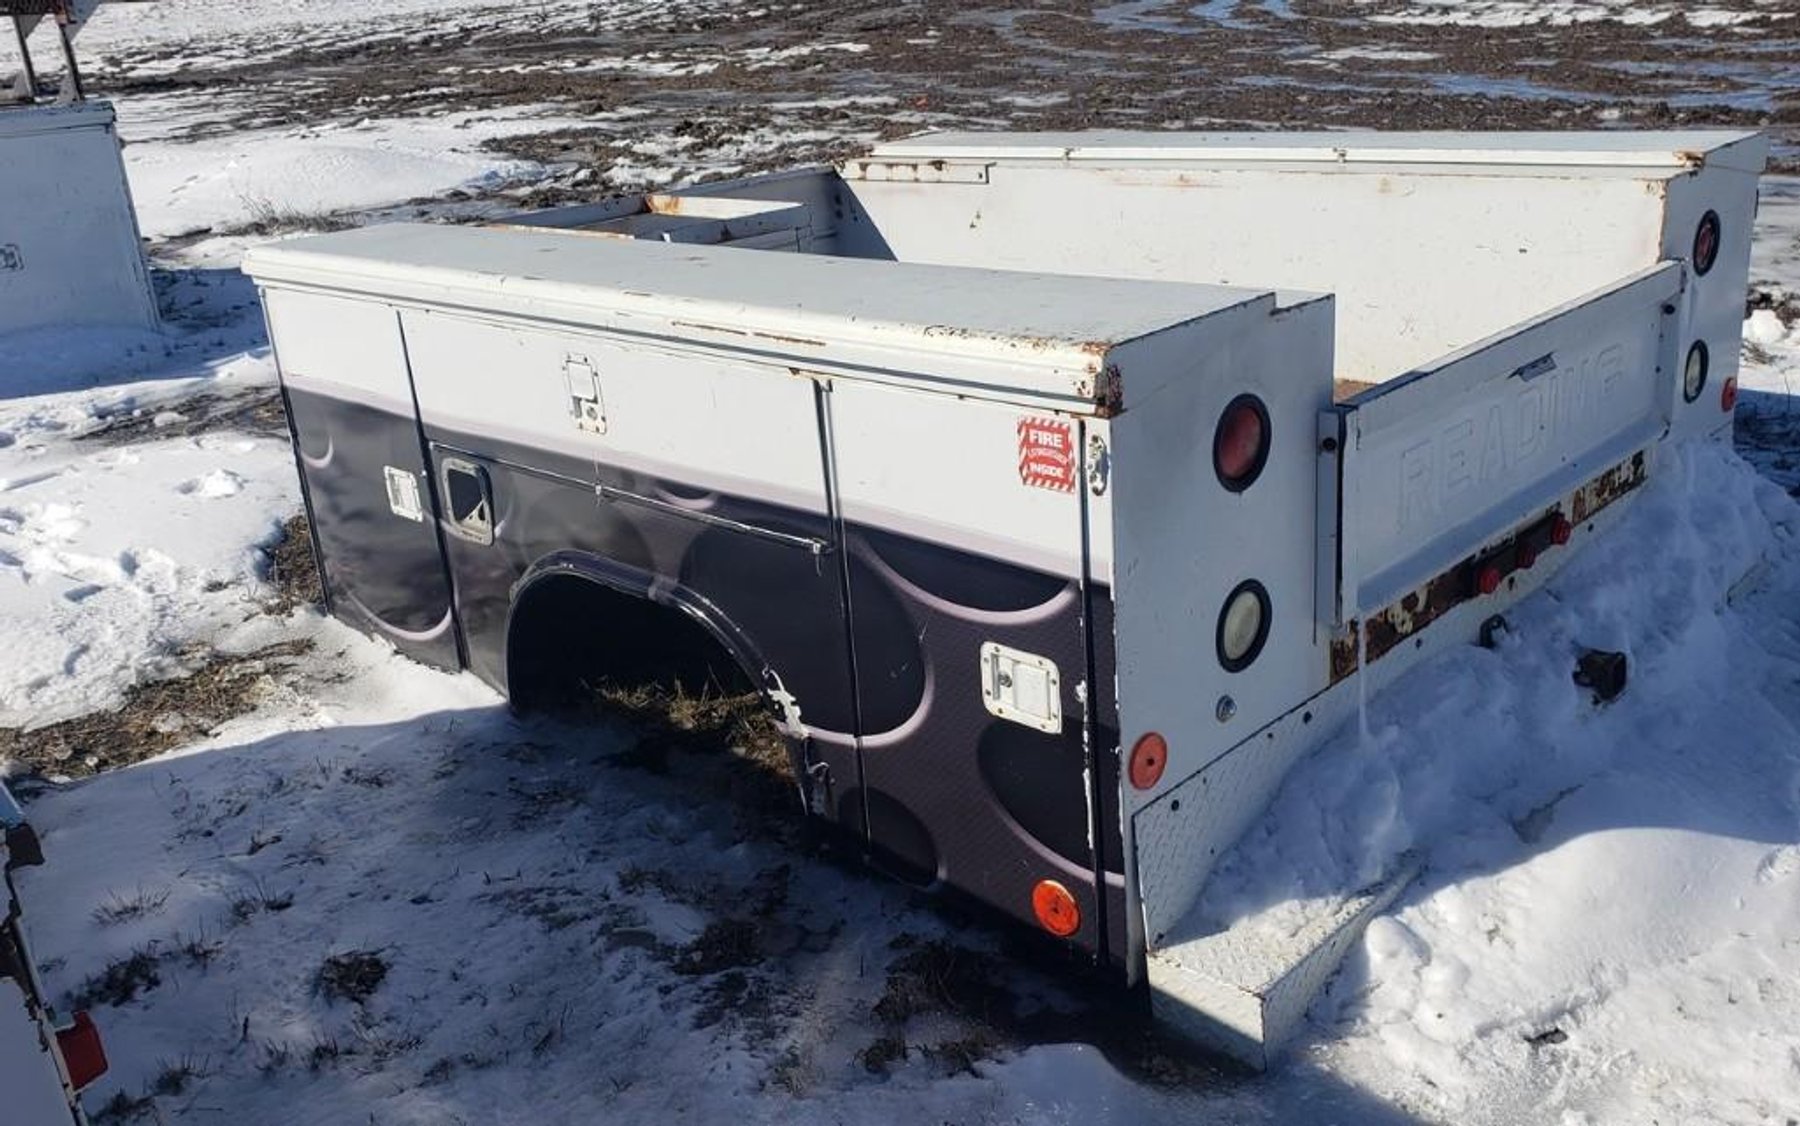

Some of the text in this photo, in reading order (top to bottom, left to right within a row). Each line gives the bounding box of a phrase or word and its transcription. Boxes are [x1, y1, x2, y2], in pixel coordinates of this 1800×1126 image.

[1029, 429, 1063, 448] FIRE
[1399, 344, 1625, 530] READING
[1029, 463, 1065, 479] INSIDE
